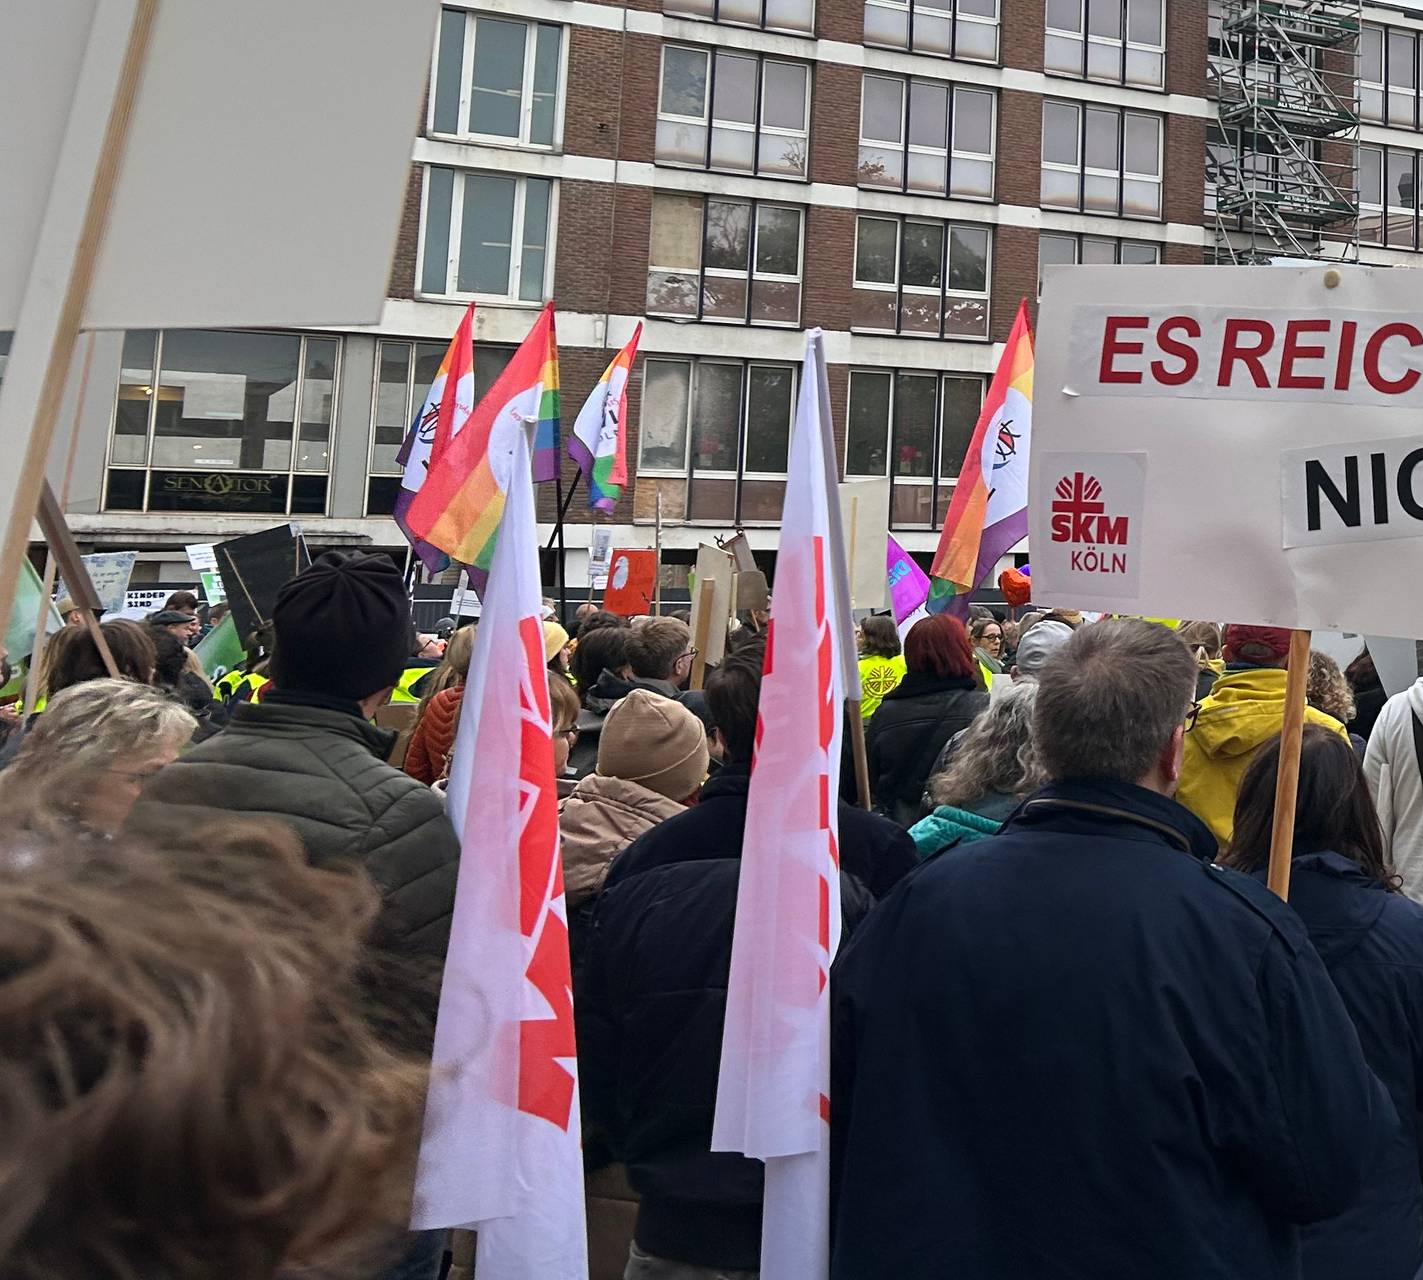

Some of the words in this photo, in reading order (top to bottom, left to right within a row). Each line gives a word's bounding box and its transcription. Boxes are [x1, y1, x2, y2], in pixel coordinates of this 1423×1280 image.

[1098, 316, 1201, 386] ES
[163, 474, 273, 494] SENATOR
[1051, 514, 1129, 545] SKM
[1071, 546, 1126, 574] KÖLN
[127, 591, 166, 599] KINDER
[127, 600, 152, 608] SIND
